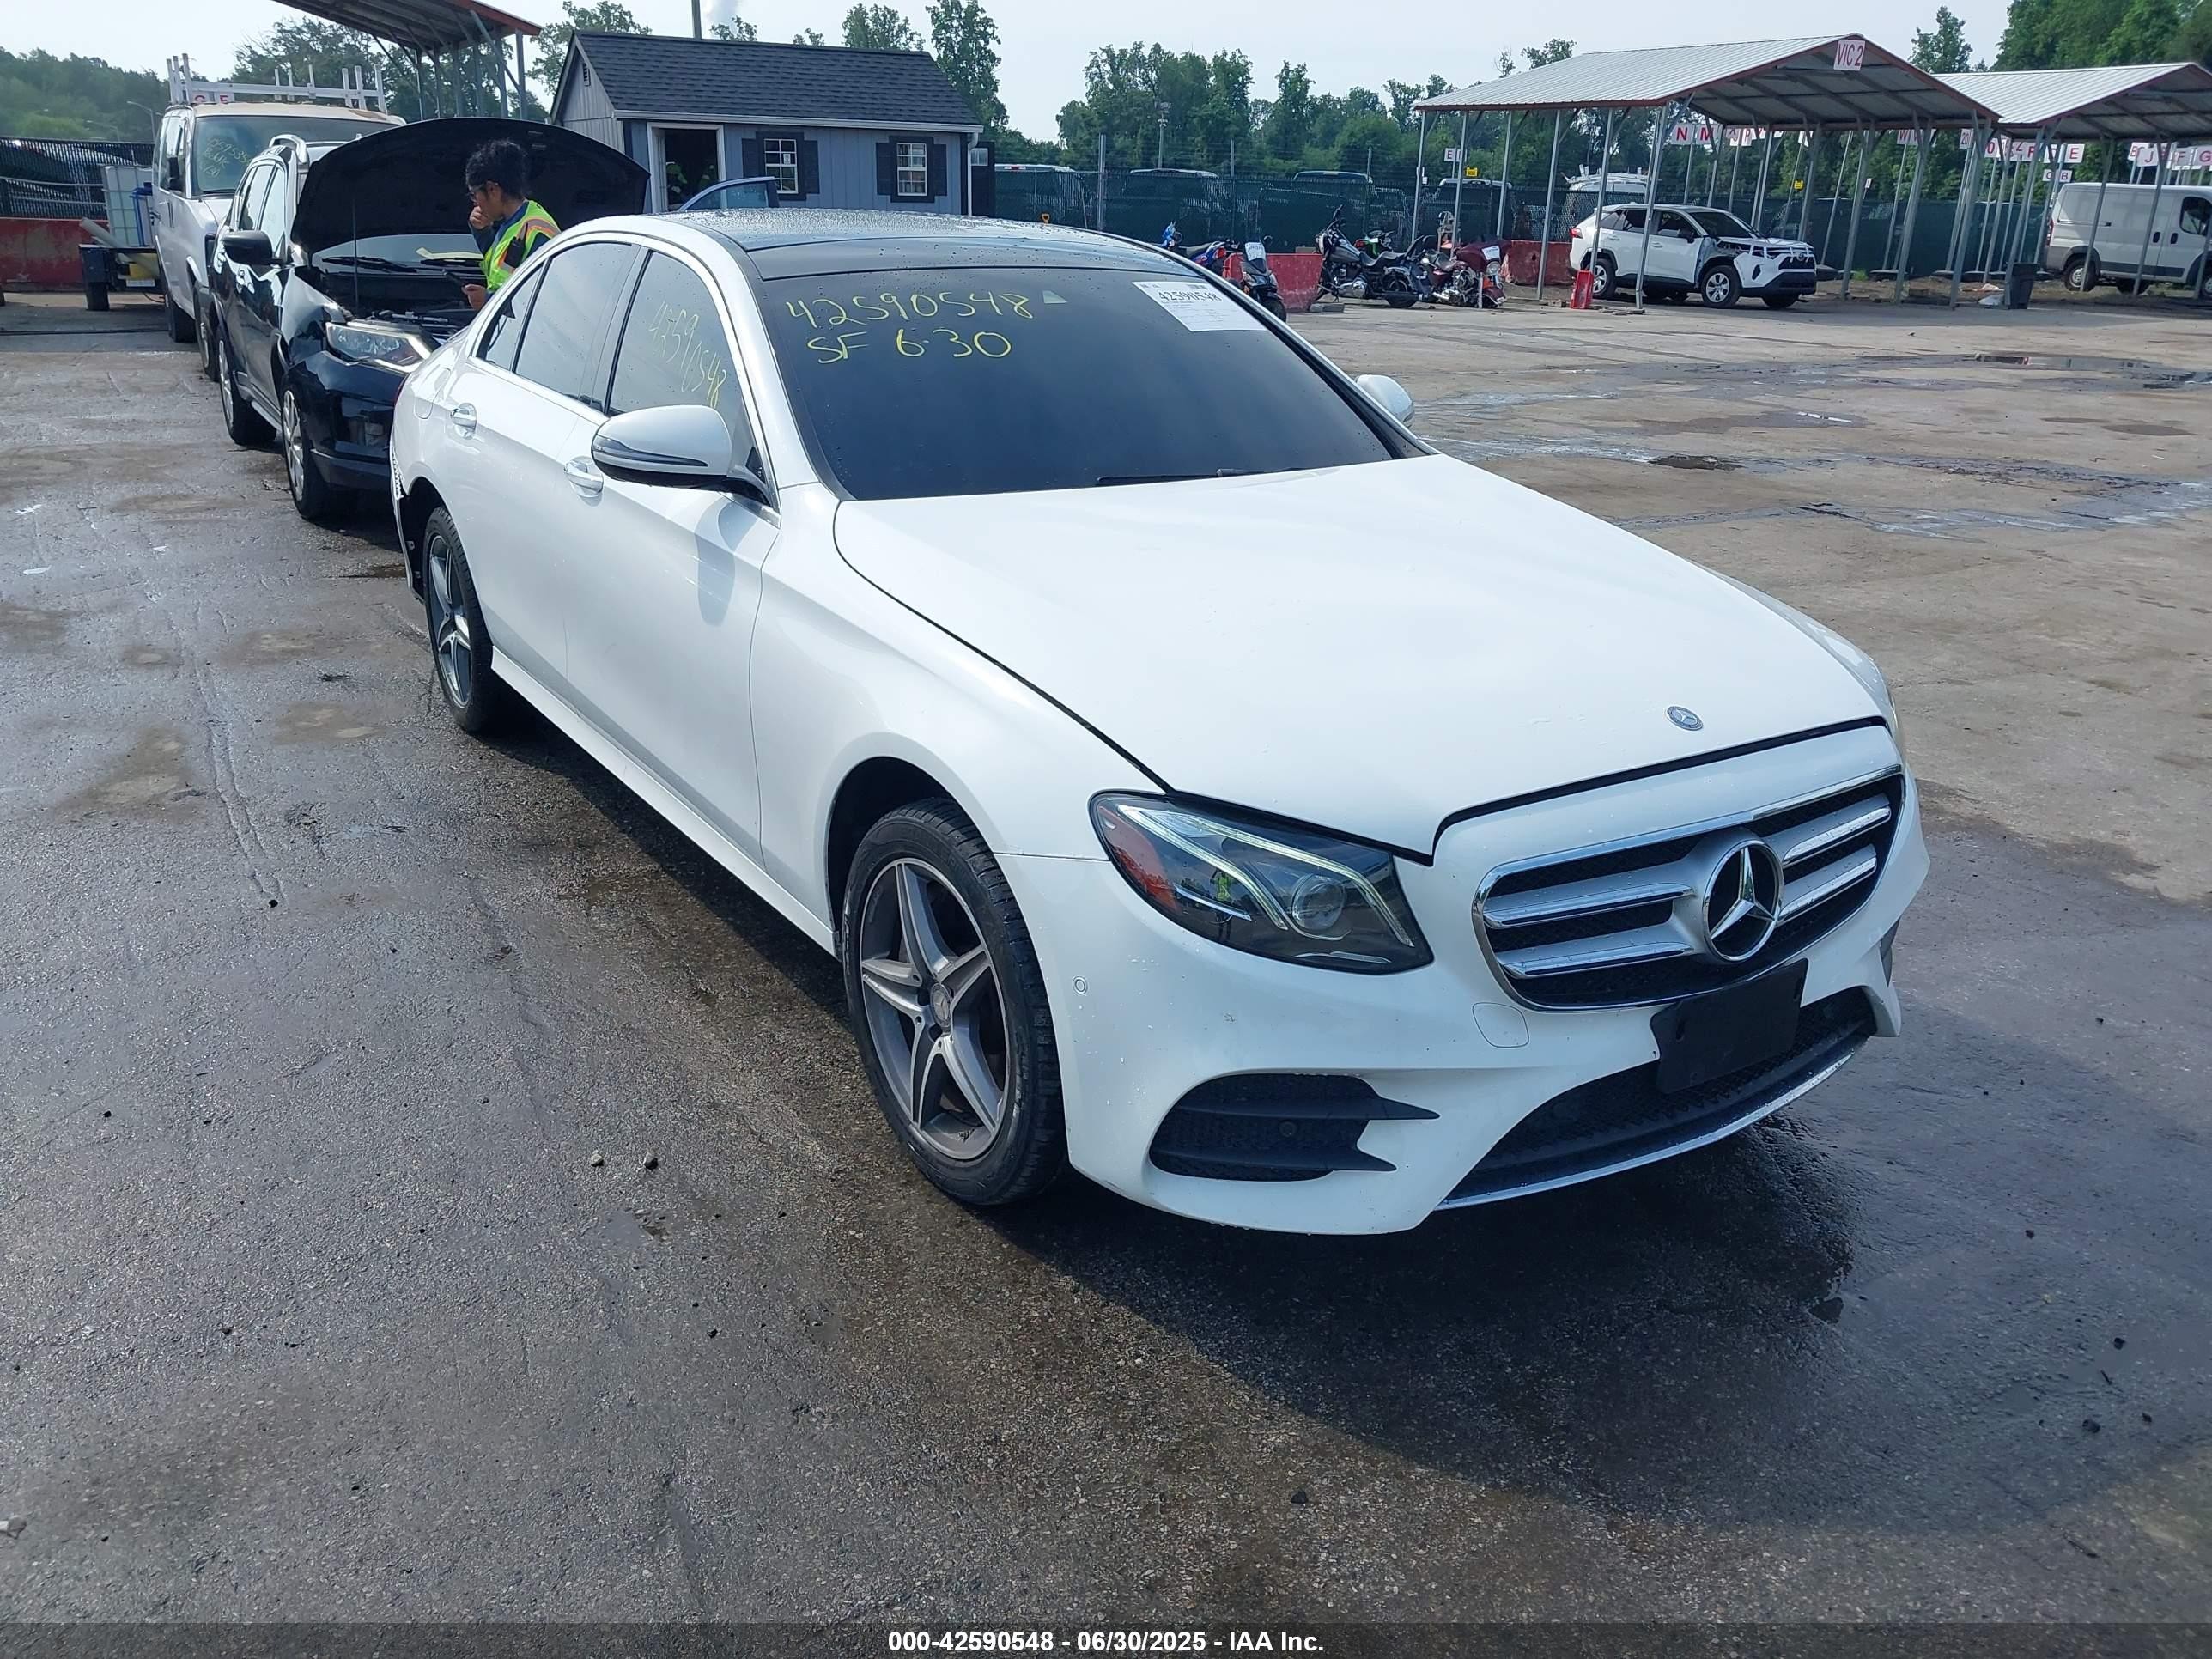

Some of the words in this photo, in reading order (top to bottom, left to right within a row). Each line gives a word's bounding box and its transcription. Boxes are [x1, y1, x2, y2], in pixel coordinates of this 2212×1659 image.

[1838, 43, 1856, 66] VIC
[1855, 45, 1864, 66] 2
[1676, 126, 1689, 142] N
[2069, 147, 2079, 160] E
[2144, 150, 2154, 163] J
[2199, 149, 2212, 163] G
[786, 290, 1033, 329] 42590548
[807, 331, 869, 364] SF
